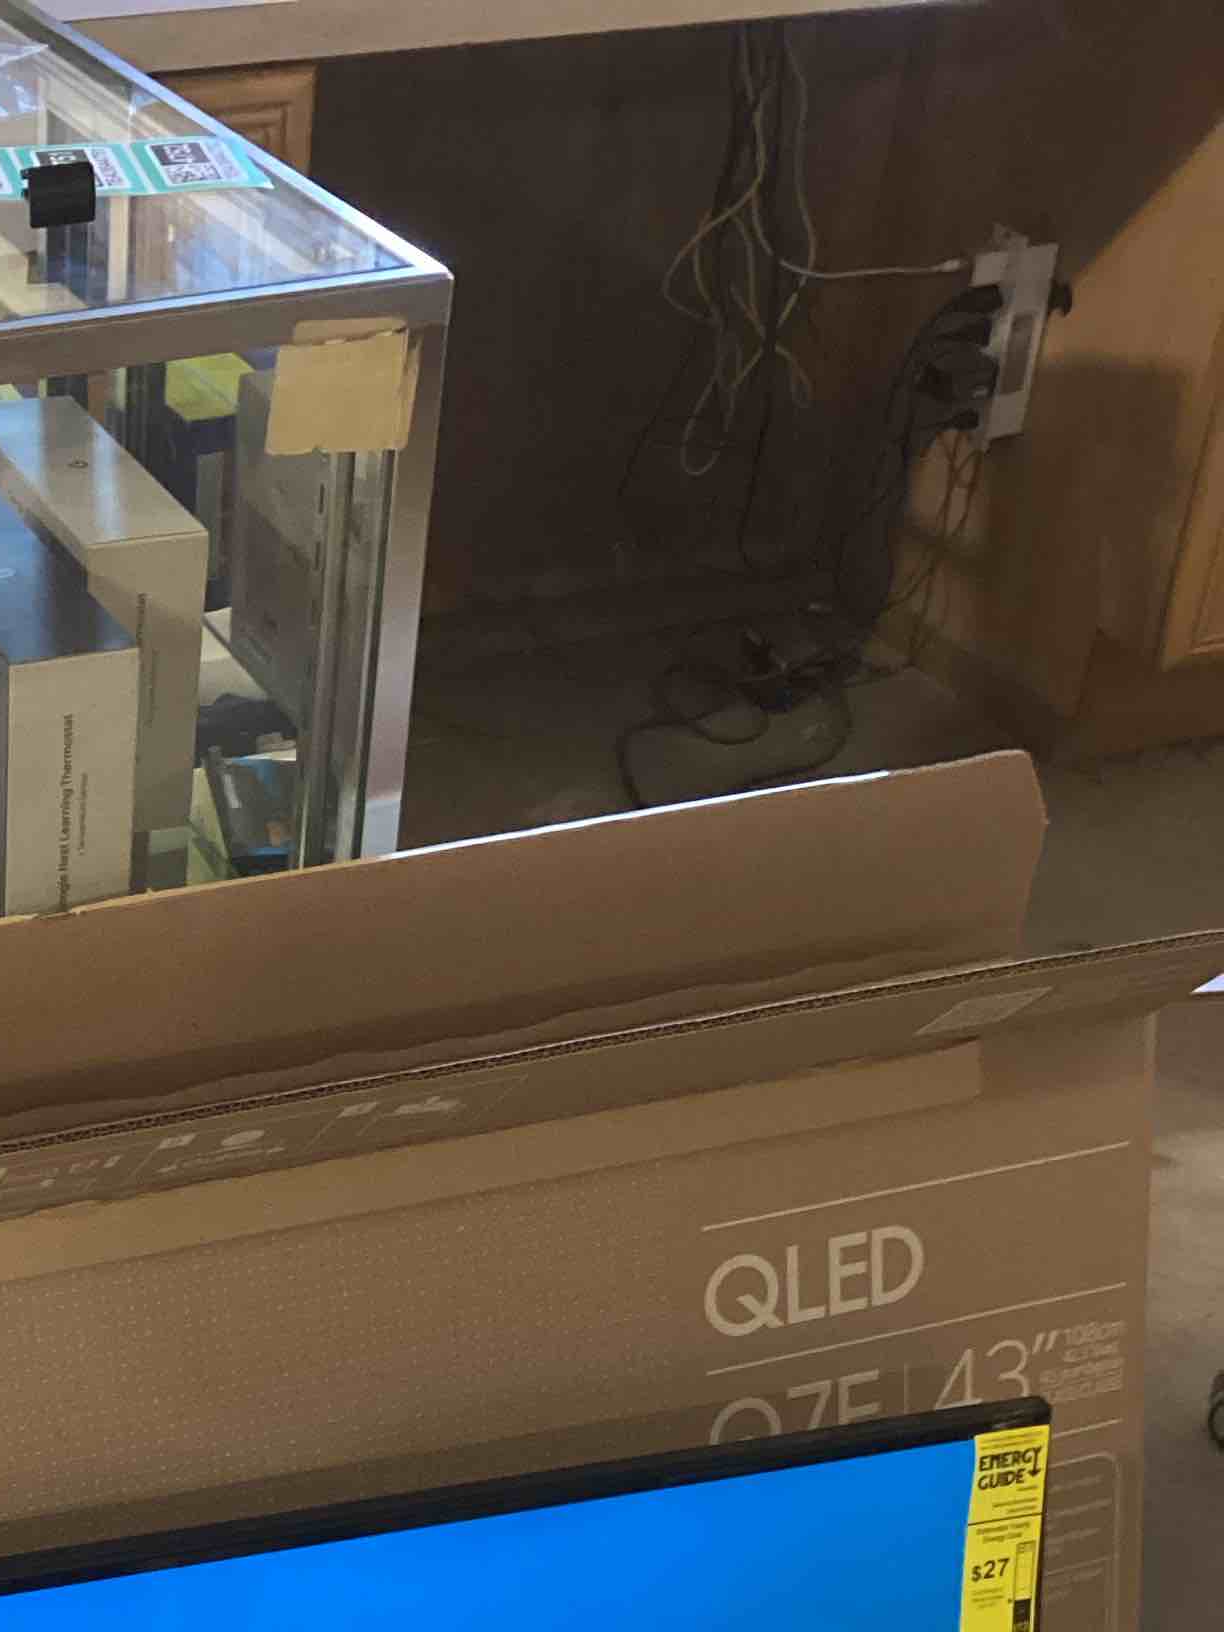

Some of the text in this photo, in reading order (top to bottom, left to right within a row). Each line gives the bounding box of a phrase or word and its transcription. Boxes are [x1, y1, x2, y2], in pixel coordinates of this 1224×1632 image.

[61, 713, 74, 788] Thermostat
[59, 788, 74, 842] Learning
[703, 1224, 925, 1337] QLED
[977, 1468, 1026, 1491] GUIDE
[978, 1445, 1043, 1473] ENERGY
[970, 1556, 1011, 1583] $27
